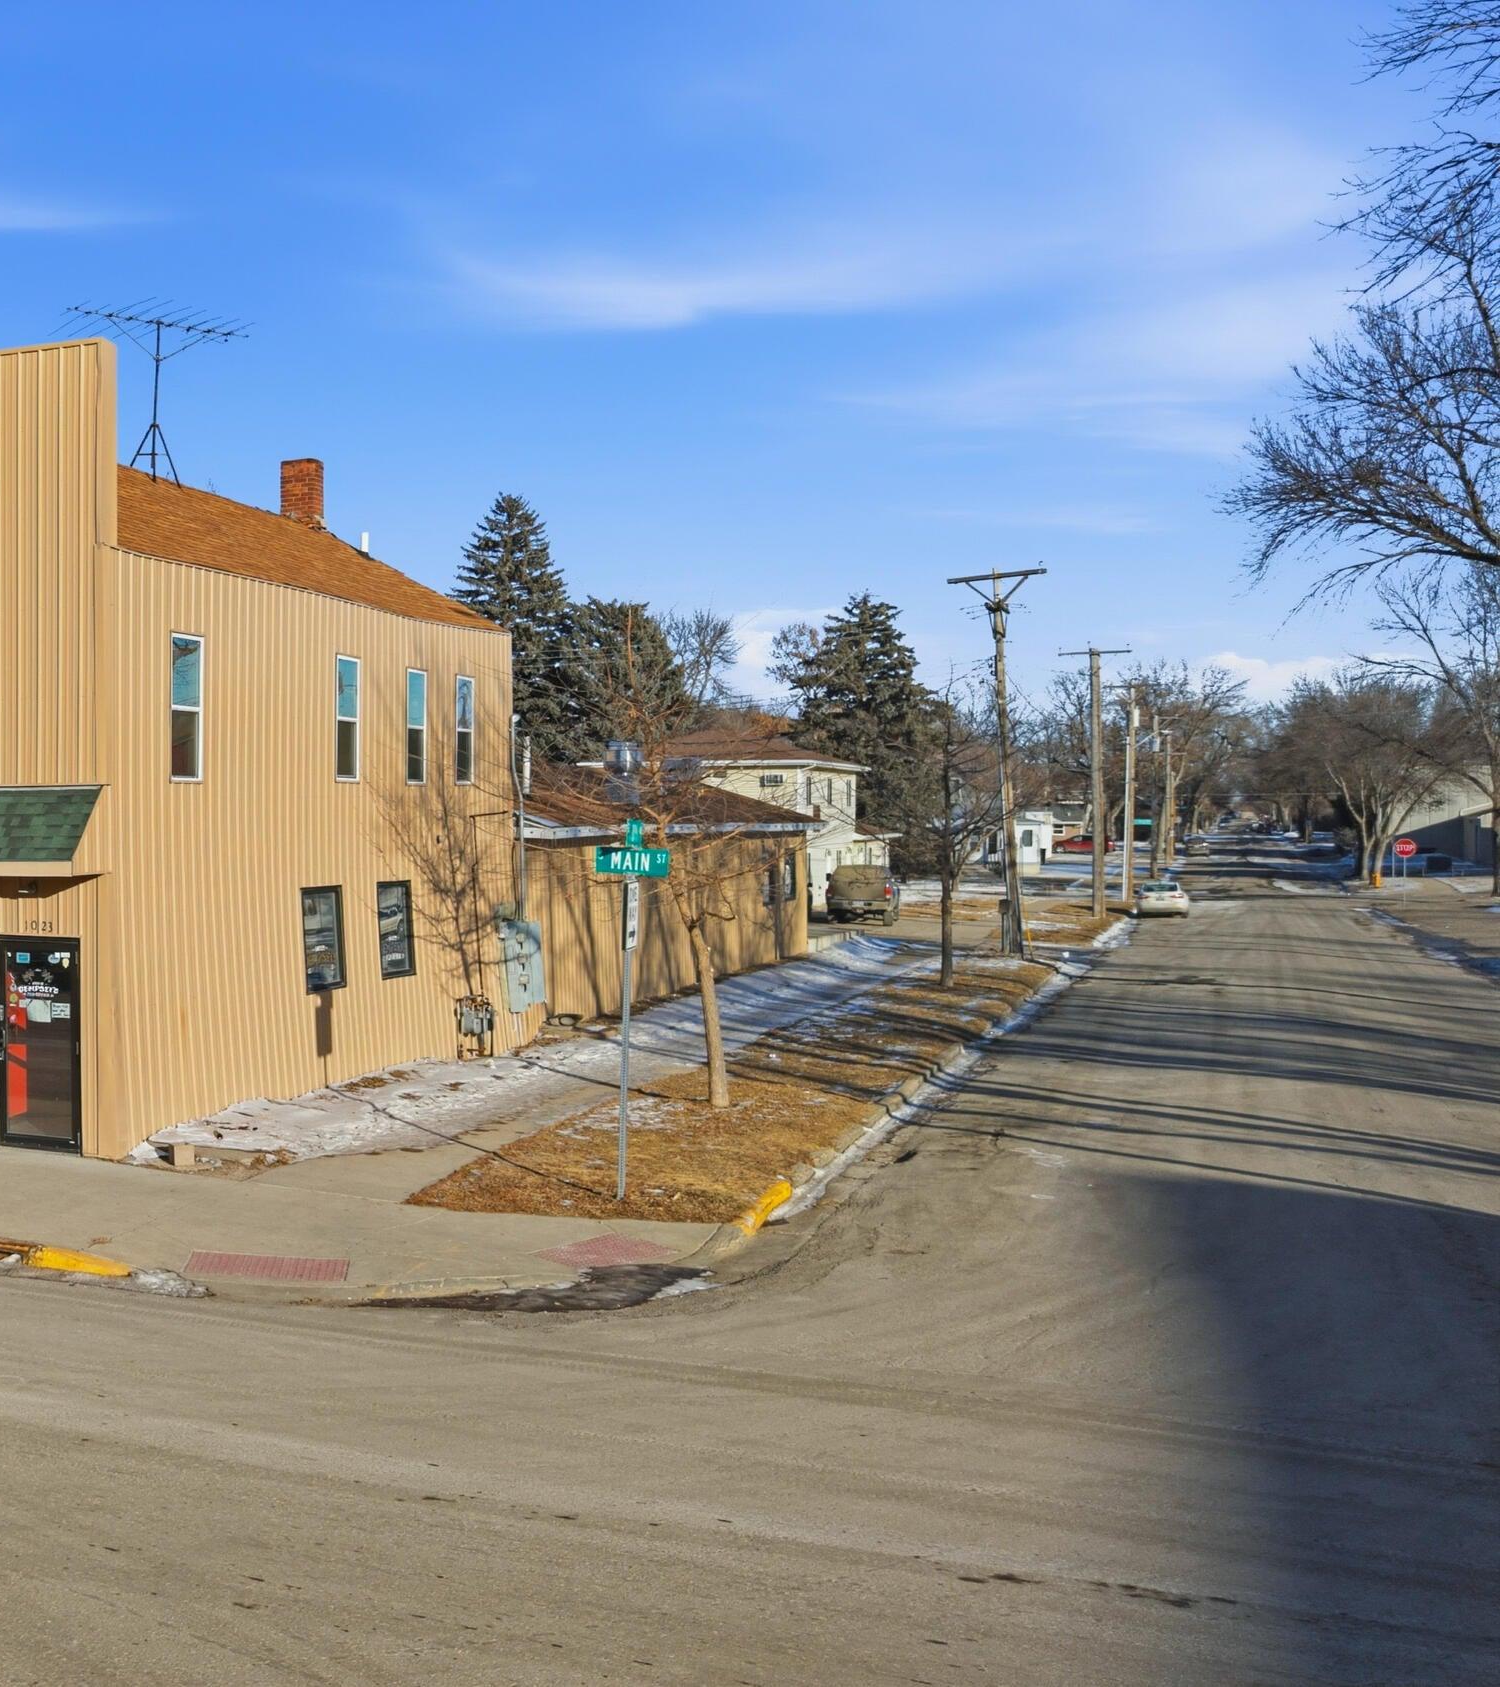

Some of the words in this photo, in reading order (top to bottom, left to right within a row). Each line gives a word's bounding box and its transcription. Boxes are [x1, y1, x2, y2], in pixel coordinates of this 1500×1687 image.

[610, 851, 650, 872] MAIN
[656, 854, 667, 864] ST
[25, 919, 53, 933] 1023
